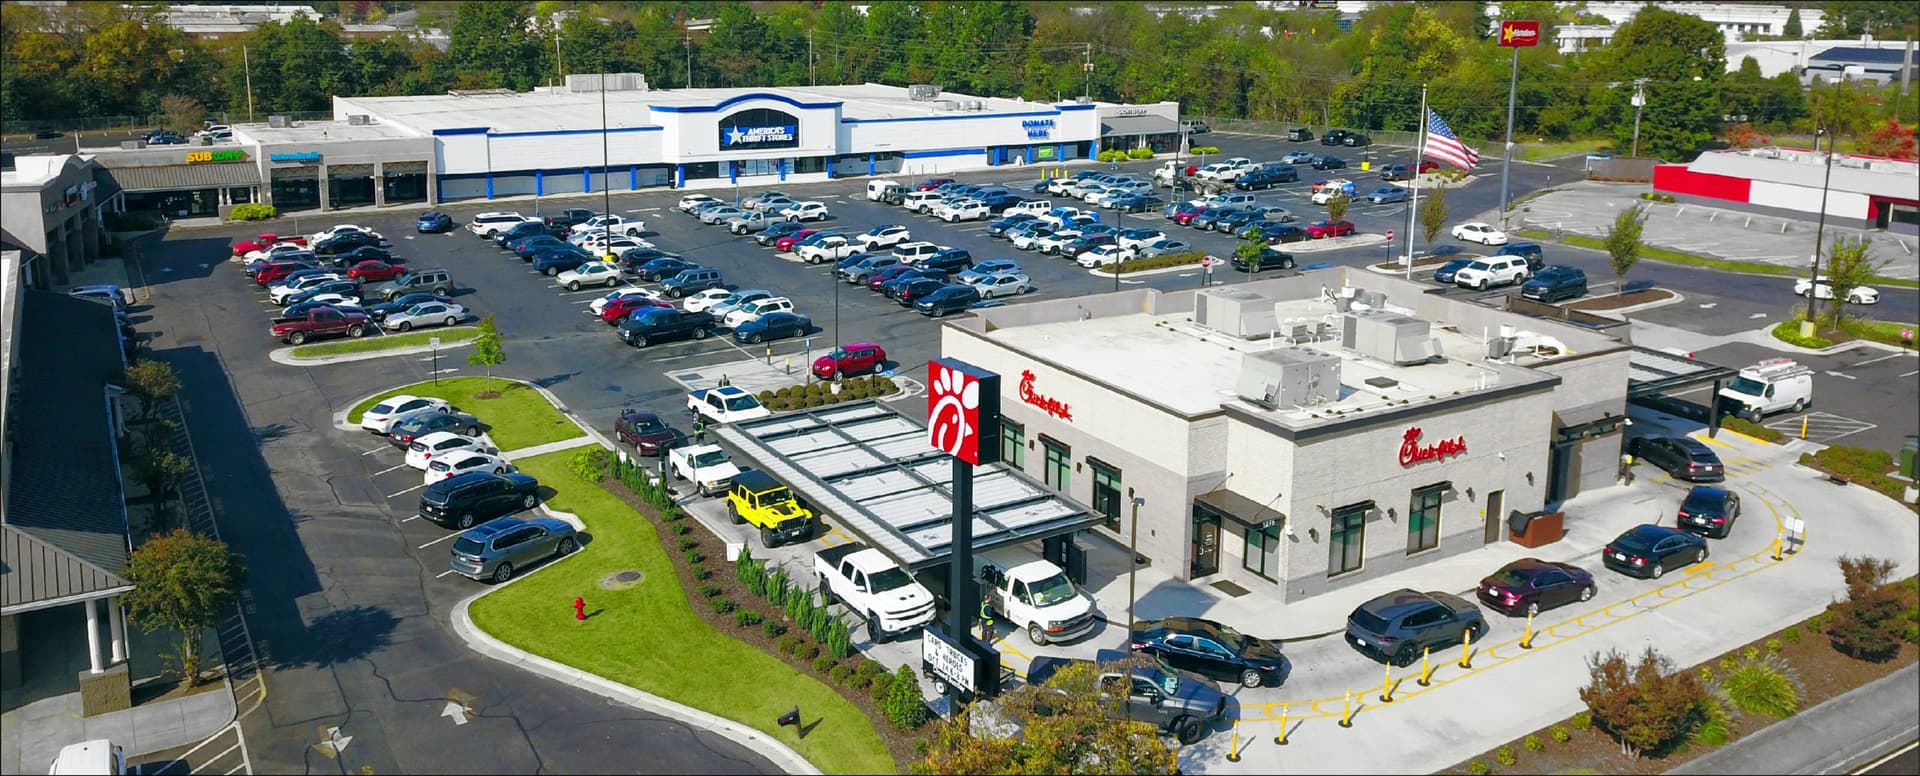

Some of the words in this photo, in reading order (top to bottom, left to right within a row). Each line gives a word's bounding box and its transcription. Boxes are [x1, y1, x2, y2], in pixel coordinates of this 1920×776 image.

[1022, 119, 1055, 128] DONATE
[742, 135, 767, 143] THRIFT
[767, 133, 793, 142] STORES
[1027, 129, 1049, 138] HERE
[186, 150, 245, 164] SUBWAY
[927, 633, 942, 650] CARS
[946, 645, 968, 667] TRUCKS
[942, 654, 963, 673] HEROES
